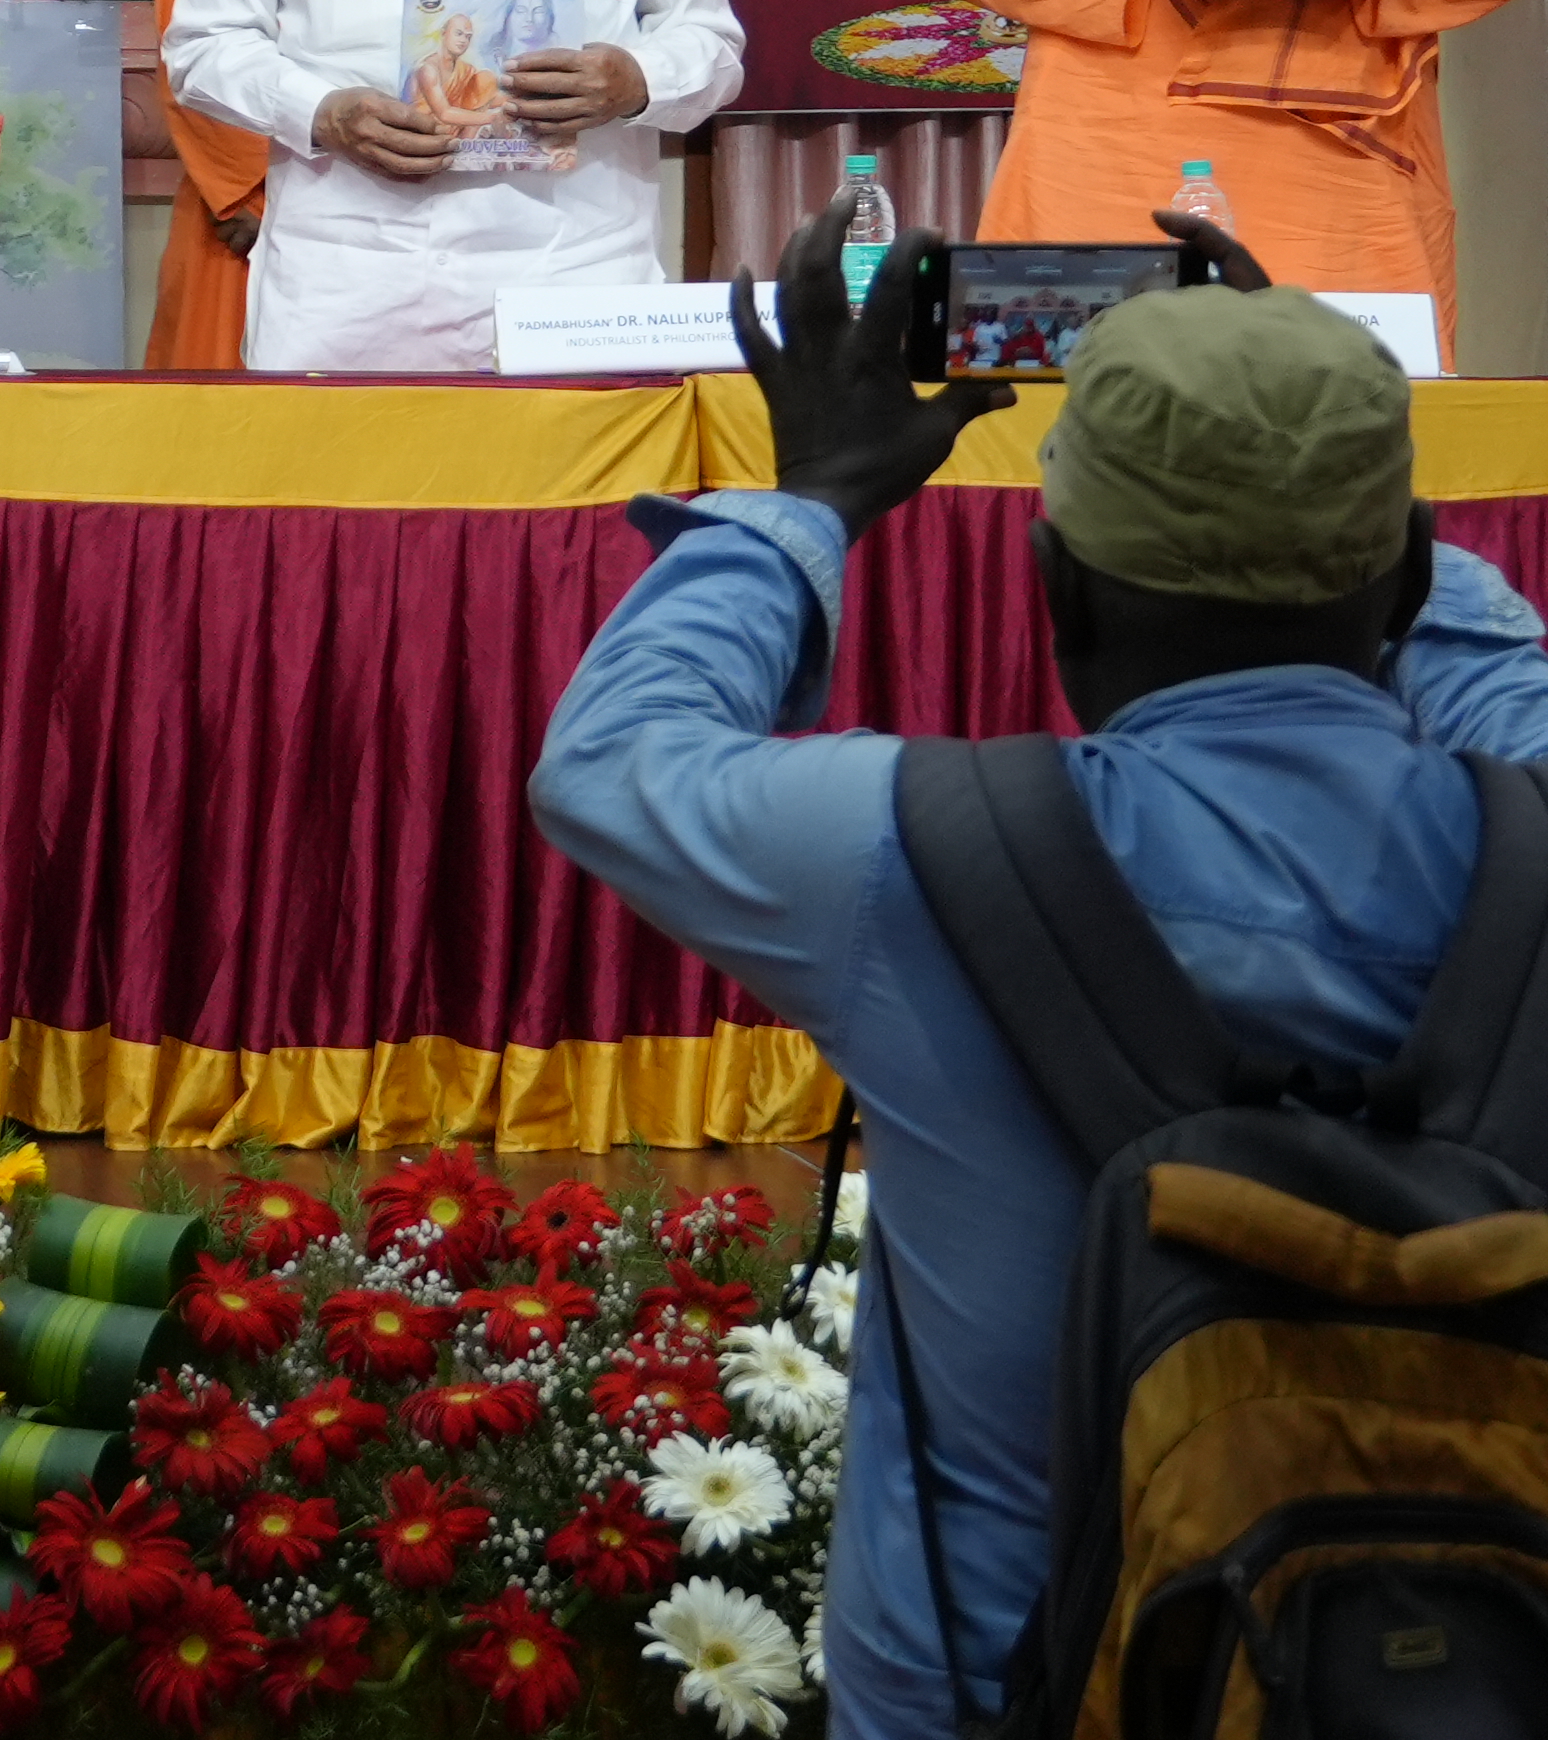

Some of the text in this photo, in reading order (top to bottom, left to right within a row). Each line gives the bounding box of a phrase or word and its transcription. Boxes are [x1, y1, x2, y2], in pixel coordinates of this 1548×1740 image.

[617, 315, 643, 327] DR.
[647, 313, 689, 326] NALLI
[565, 334, 647, 347] INDUSTRIALIST
[651, 334, 660, 345] &
